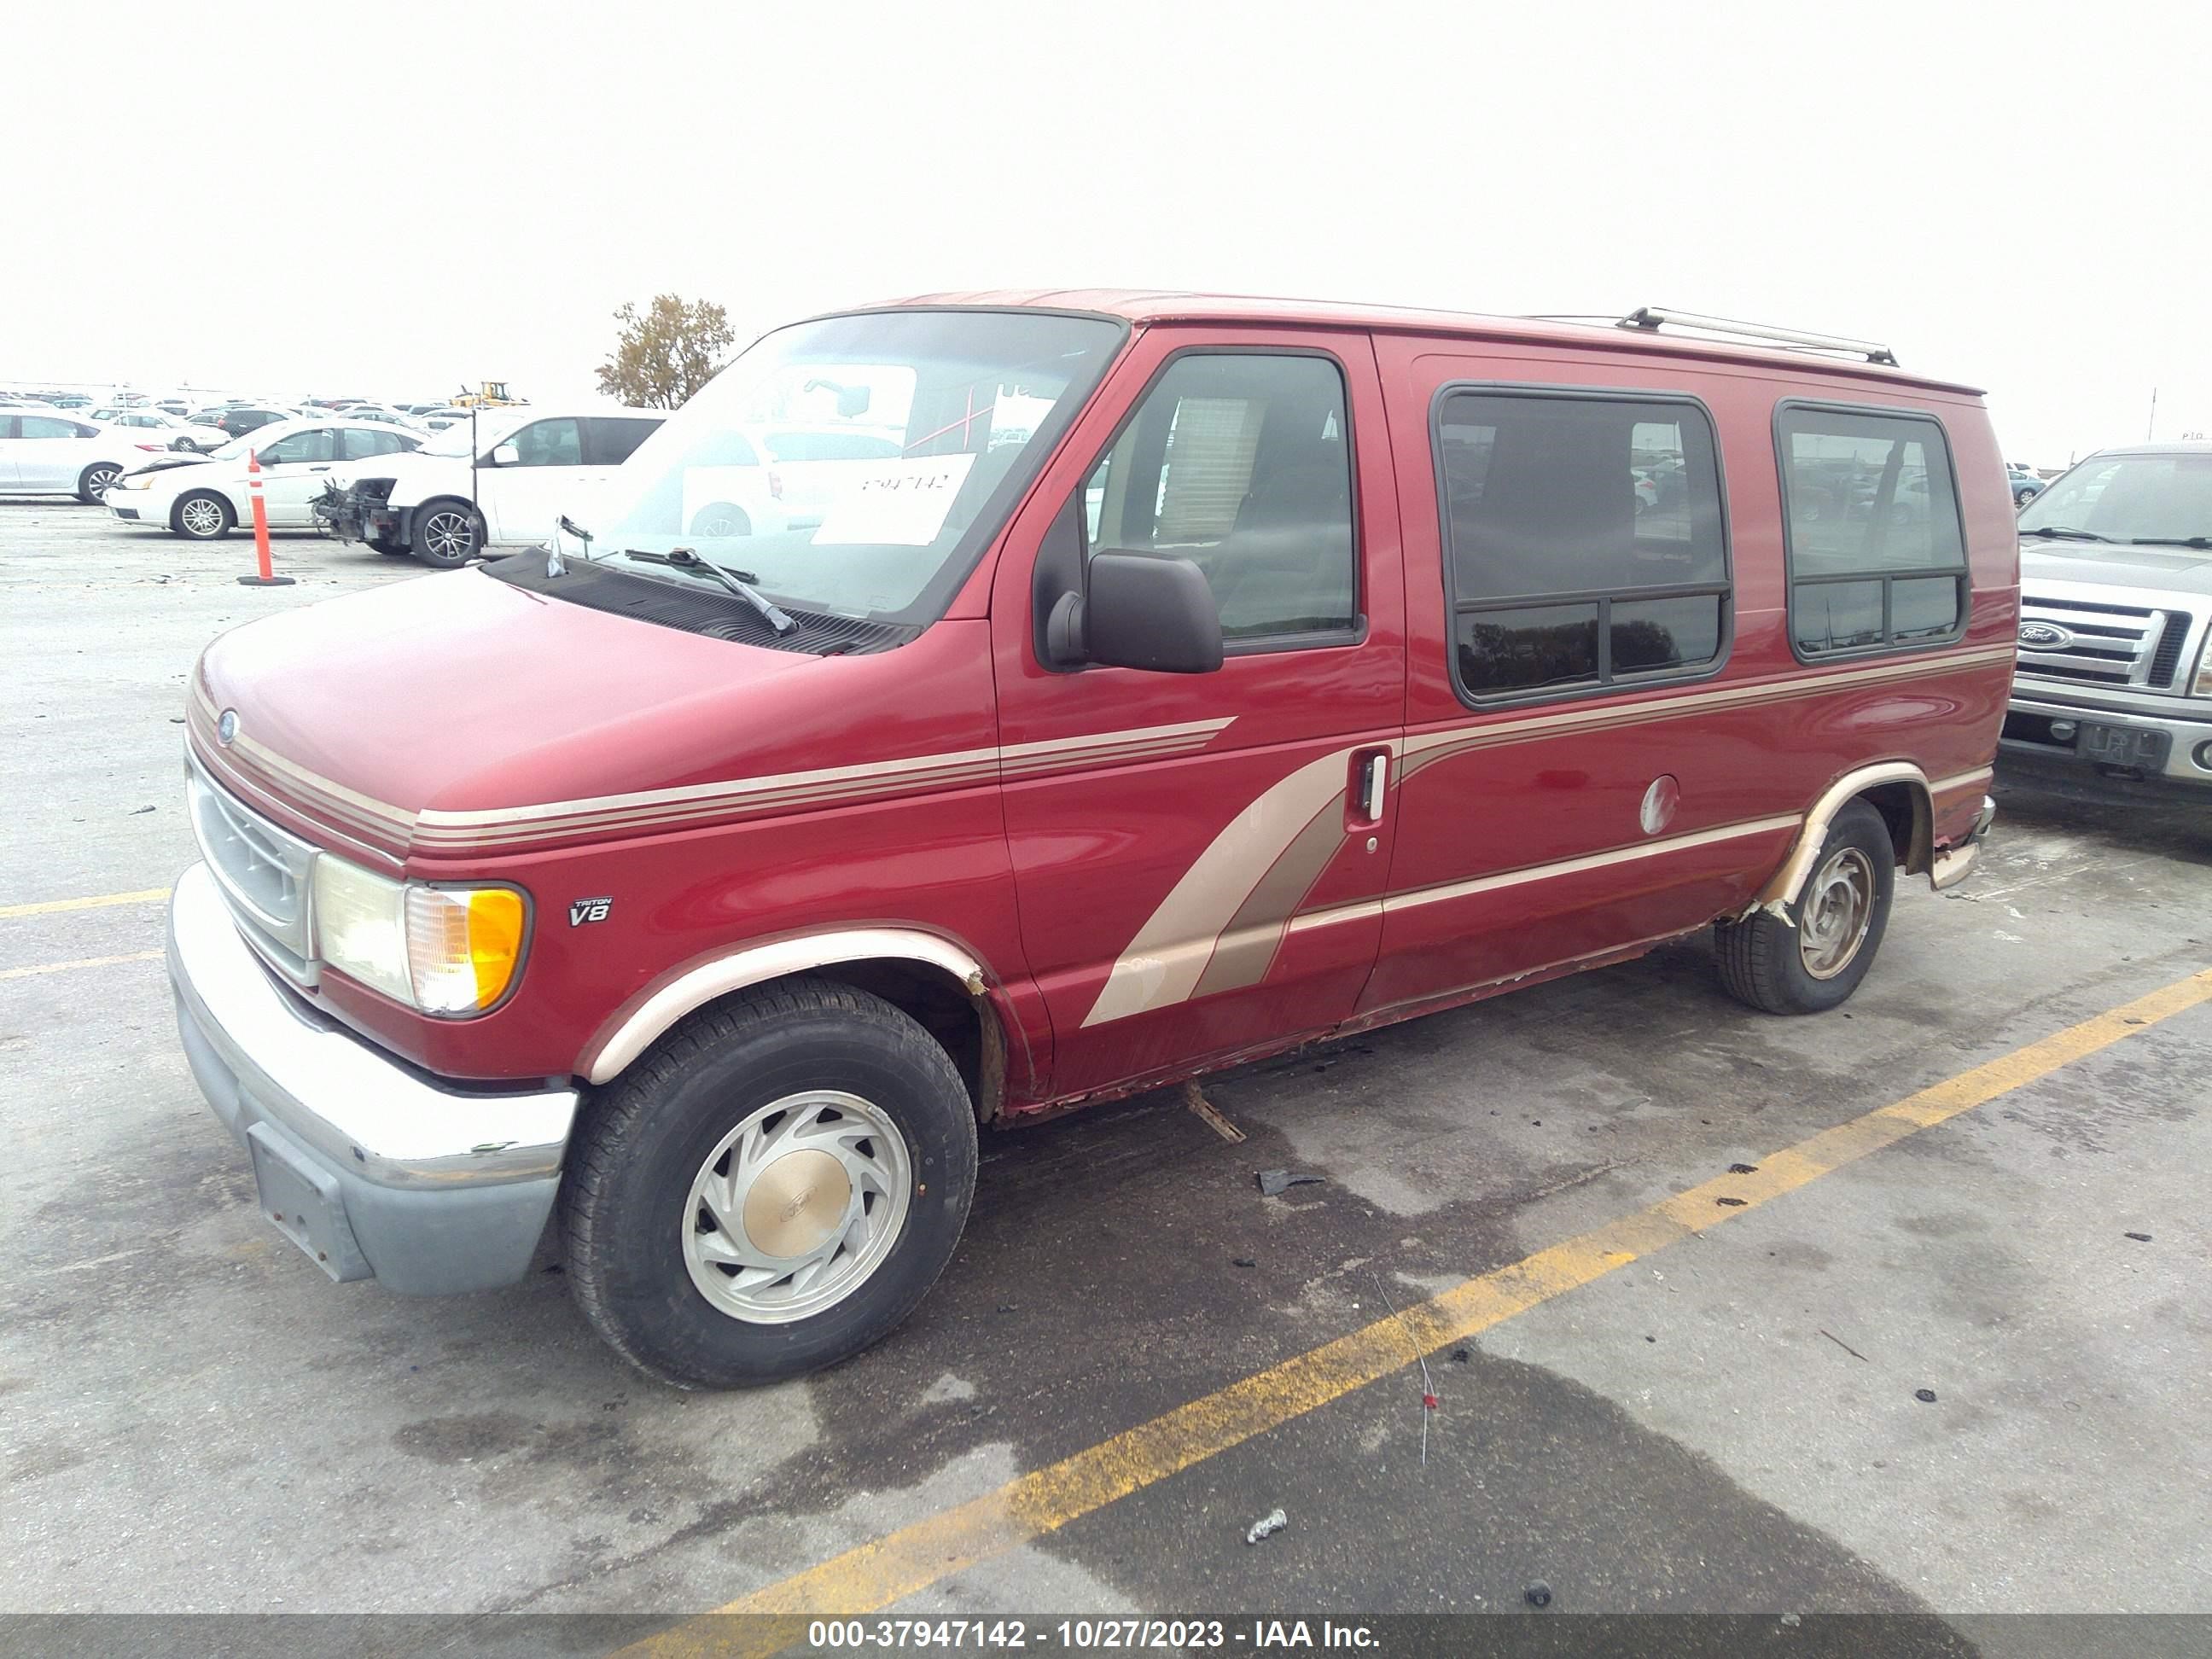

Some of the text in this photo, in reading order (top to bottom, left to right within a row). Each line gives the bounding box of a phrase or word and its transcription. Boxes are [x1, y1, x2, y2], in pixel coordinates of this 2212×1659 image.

[2021, 626, 2052, 640] Ford
[575, 898, 613, 907] TRITON
[570, 905, 610, 926] V8
